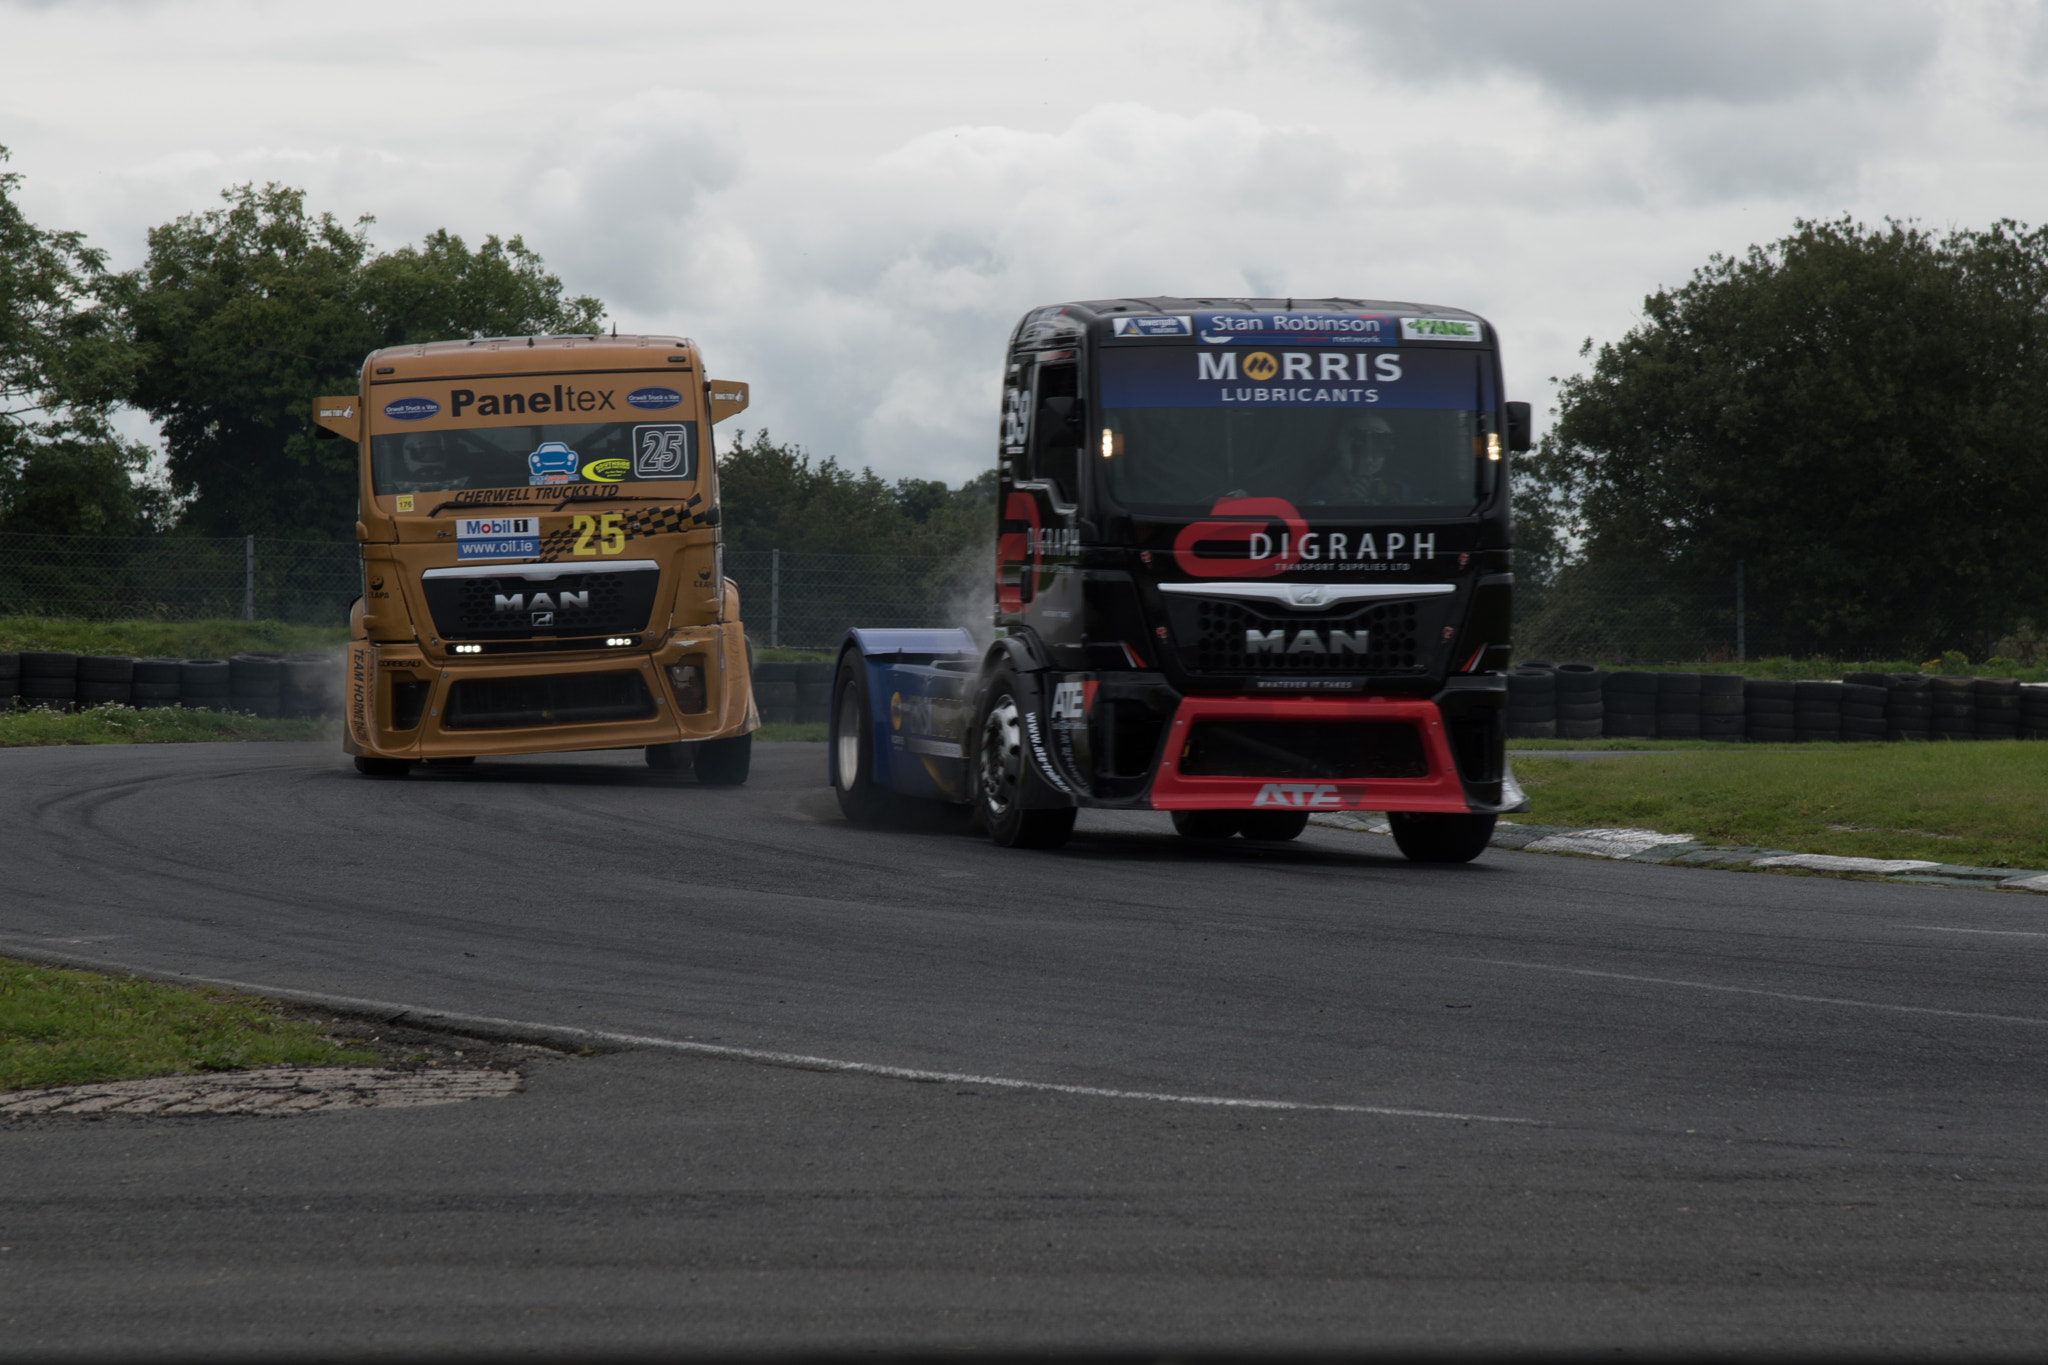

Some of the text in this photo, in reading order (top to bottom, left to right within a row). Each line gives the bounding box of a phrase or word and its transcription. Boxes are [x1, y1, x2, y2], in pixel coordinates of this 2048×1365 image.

[1211, 314, 1382, 332] Stan Robinson
[1196, 351, 1404, 382] MORRIS
[451, 384, 617, 418] Paneltex
[1220, 387, 1381, 403] LUBRICANTS
[638, 430, 685, 472] 25
[454, 484, 619, 503] CHERWELL TRUCKS LTD
[466, 521, 511, 535] Mobil
[572, 513, 626, 556] 25
[462, 541, 534, 554] www.oil.ie
[1249, 532, 1436, 560] DIGRAPH
[1274, 563, 1412, 572] TRANSPORT SUPPLIES LTD
[494, 590, 590, 611] MAN
[1245, 629, 1369, 655] MAN
[354, 648, 365, 682] TEAM
[1257, 681, 1353, 689] WHATEVER IT TAKES
[354, 683, 366, 720] HORNE
[1050, 681, 1086, 719] ATE
[1251, 783, 1343, 807] ATE
